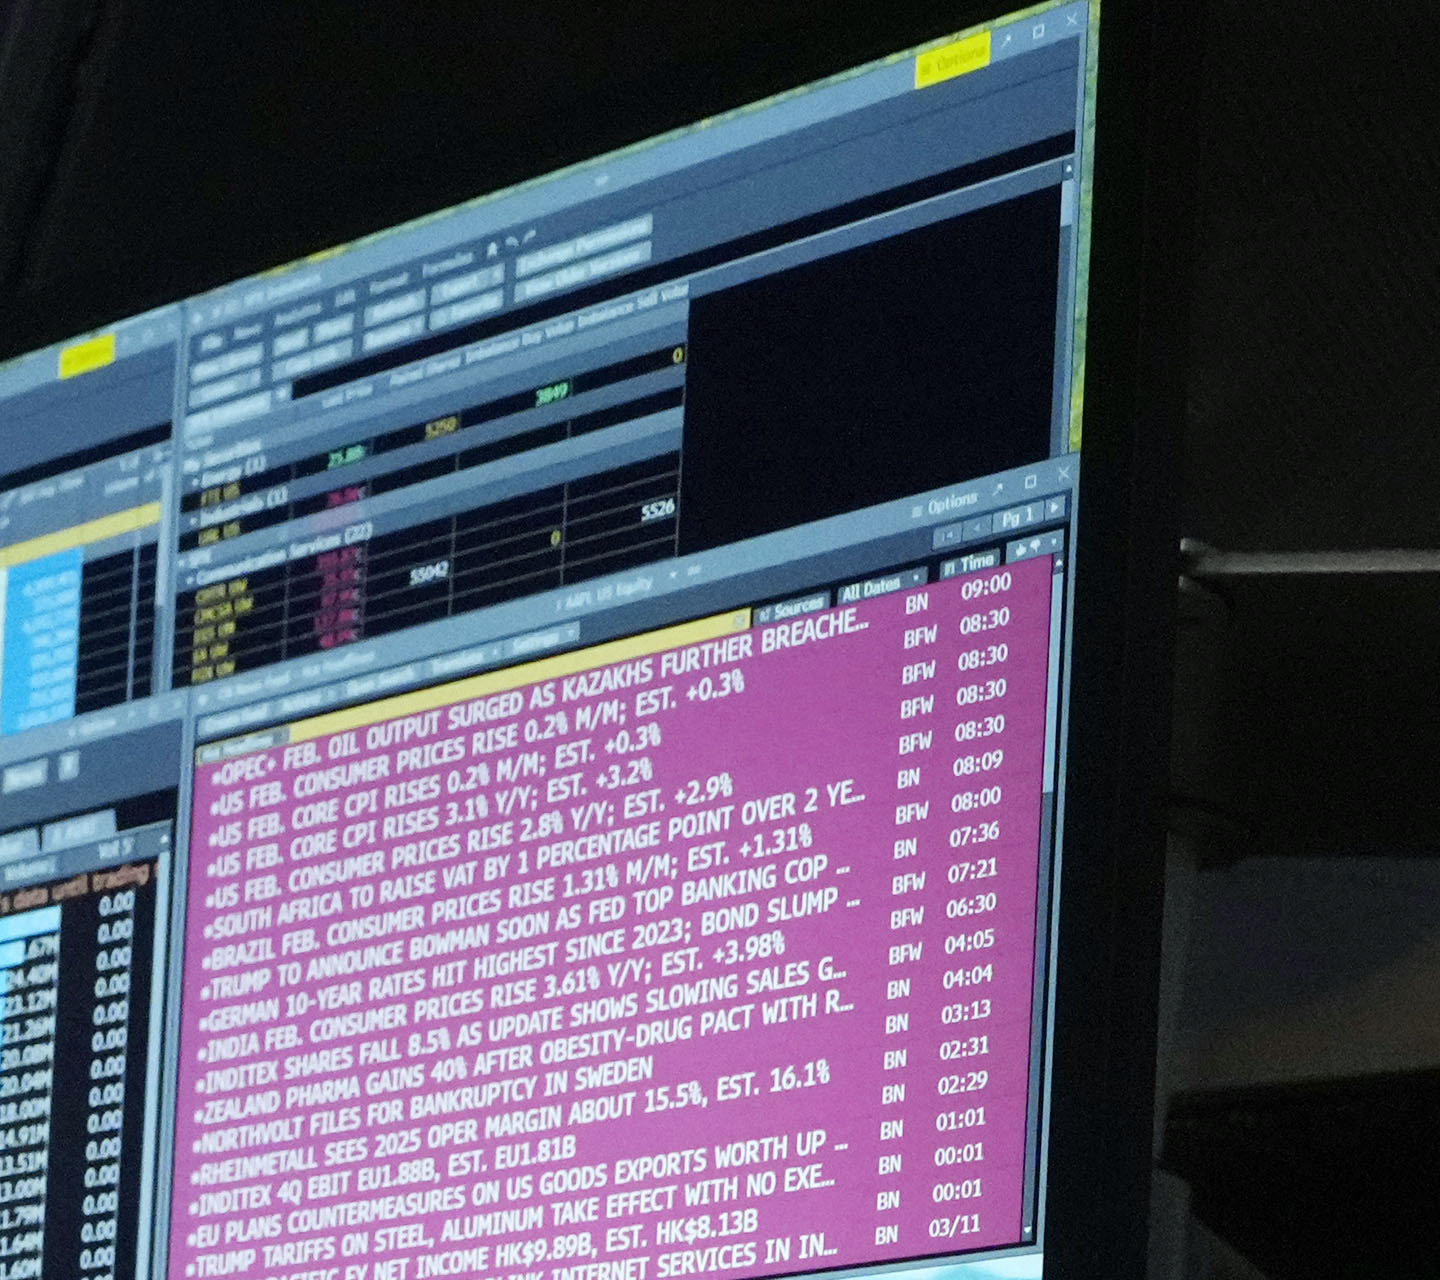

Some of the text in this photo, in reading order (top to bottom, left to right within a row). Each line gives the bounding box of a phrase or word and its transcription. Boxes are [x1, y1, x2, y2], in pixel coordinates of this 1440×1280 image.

[642, 499, 676, 521] 5526
[928, 491, 979, 514] Options
[1002, 508, 1034, 529] Pg 1
[410, 561, 450, 584] 55042
[961, 553, 994, 570] Time
[842, 577, 900, 602] All Dates
[774, 596, 824, 620] Sources
[219, 571, 1011, 785] OPEC+ FEB. OIL OUTPUT SURGED AS KAZAKHS FURTHER BREACHE... BN 09:00
[196, 1142, 982, 1276] TRUMP TARIFFS ON STEEL, ALUMINUM TAKE EFFECT WITH NO EXE... BN 00:01
[656, 1241, 756, 1278] SERVICES
[764, 1237, 790, 1264] IN
[798, 1232, 837, 1259] IN...
[875, 1224, 898, 1245] BN
[928, 1213, 979, 1237] 03/11
